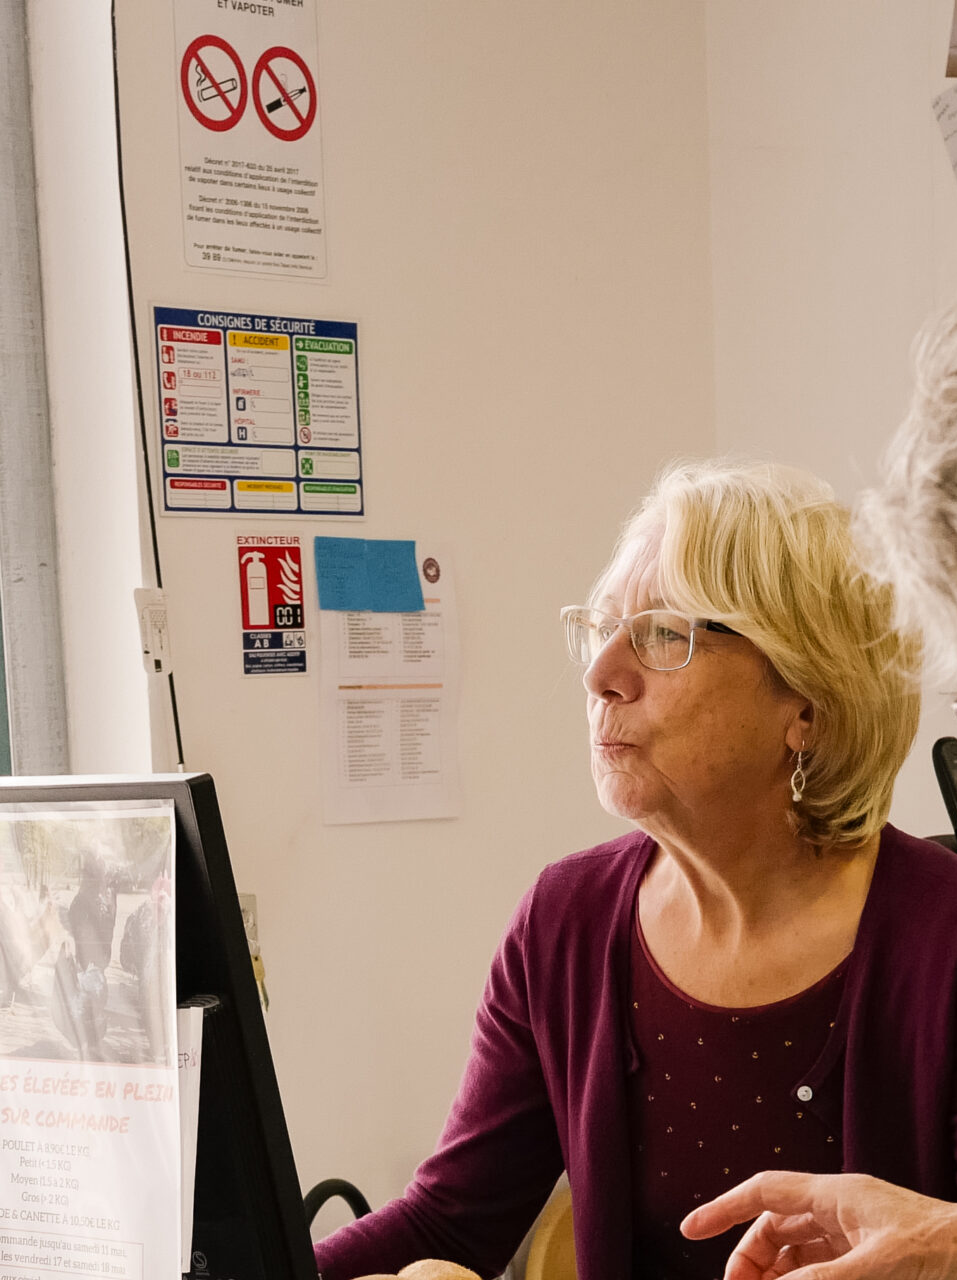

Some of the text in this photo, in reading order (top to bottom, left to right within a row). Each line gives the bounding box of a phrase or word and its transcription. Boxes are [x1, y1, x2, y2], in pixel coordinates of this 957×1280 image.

[231, 0, 275, 17] VAPOTER
[197, 313, 316, 335] CONSIGNES DE SÉCURITÉ
[172, 330, 208, 342] INCENDIE
[243, 335, 280, 347] ACCIDENT
[237, 535, 300, 545] EXTINCTEUR
[254, 638, 270, 648] A B
[23, 1068, 90, 1097] ÉLEVÉES
[95, 1080, 117, 1099] EN
[123, 1082, 174, 1102] PLEIN
[1, 1107, 130, 1134] SUR COMMANDE
[2, 1139, 36, 1152] POULET
[10, 1172, 38, 1186] Moyen
[21, 1191, 40, 1203] Gros
[12, 1209, 19, 1220] &
[20, 1210, 61, 1224] CANETTE
[1, 1250, 13, 1262] les
[14, 1252, 52, 1266] vendredi
[53, 1256, 63, 1267] 17
